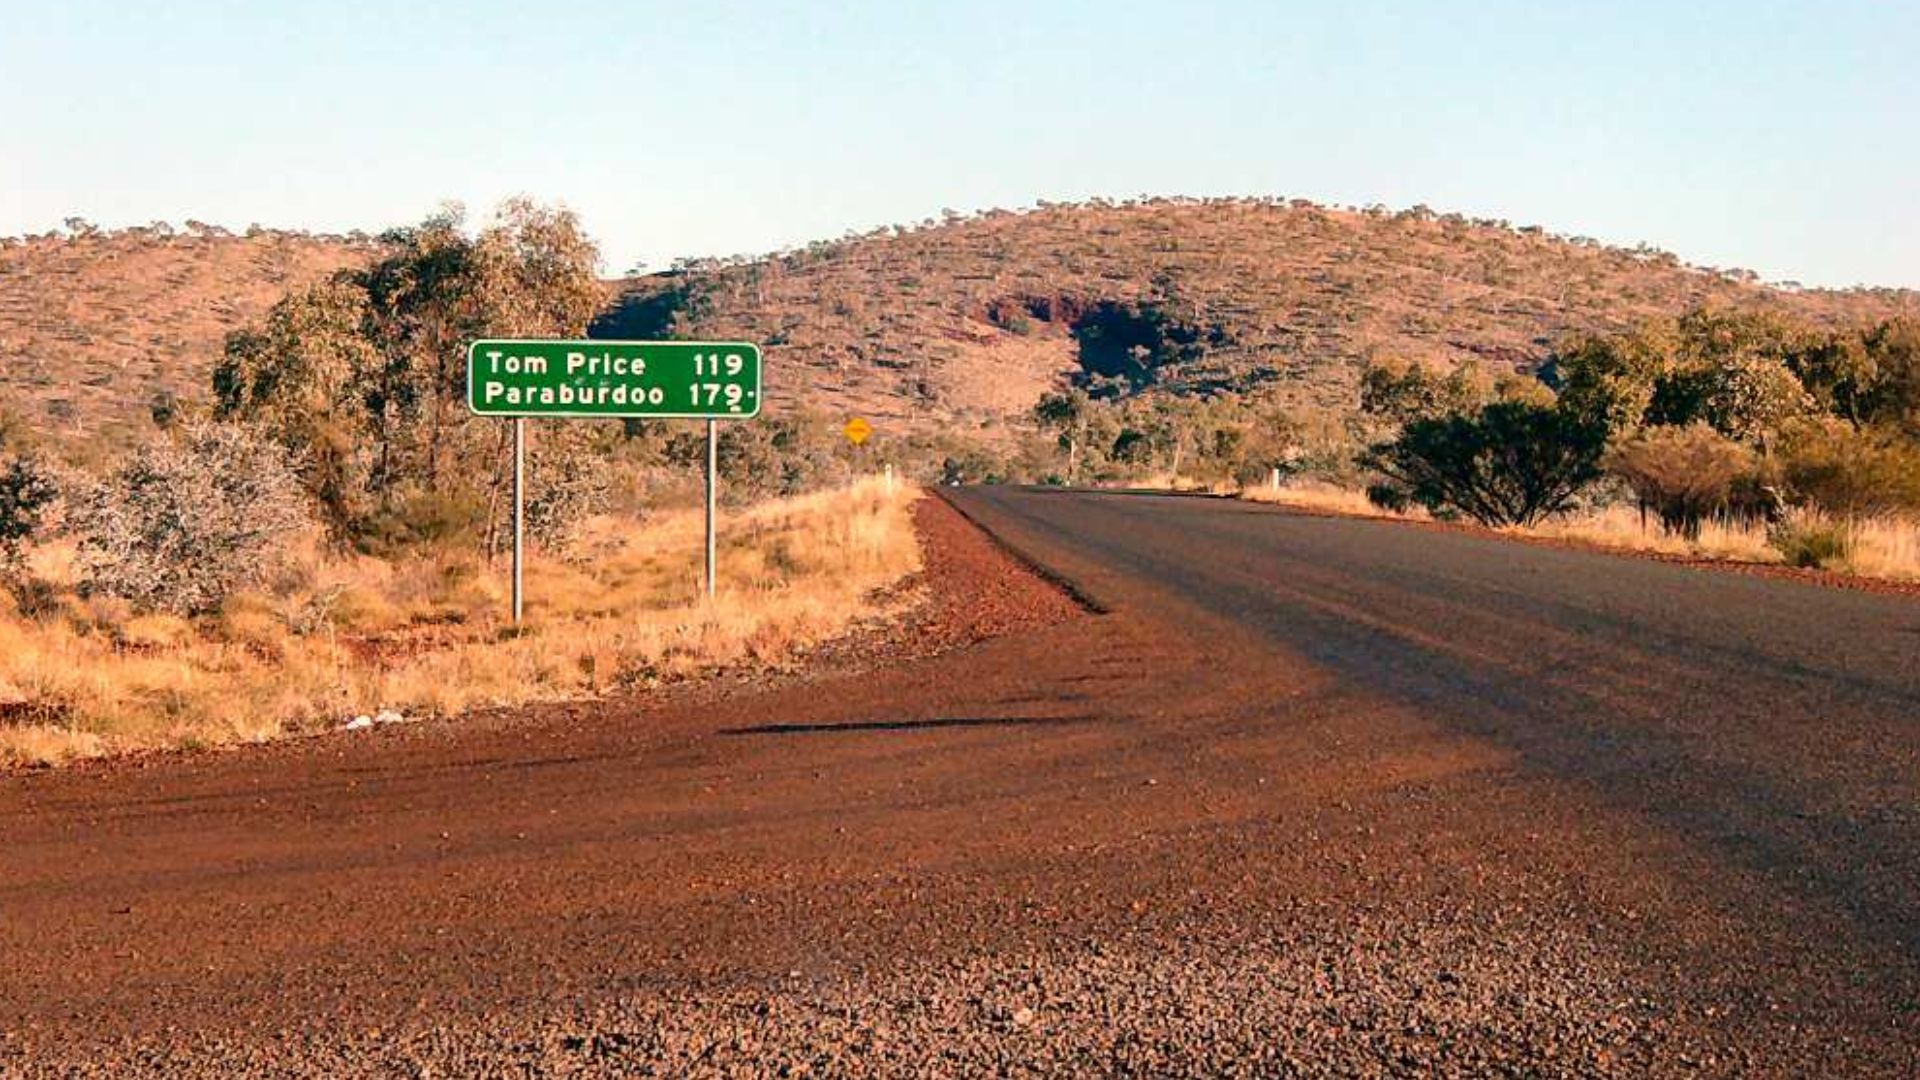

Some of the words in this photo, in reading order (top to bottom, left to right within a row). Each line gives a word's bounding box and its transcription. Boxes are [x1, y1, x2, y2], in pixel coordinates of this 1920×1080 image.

[485, 352, 548, 374] Tom
[567, 352, 646, 375] Price
[693, 354, 744, 376] 119
[485, 381, 664, 404] Paraburdoo
